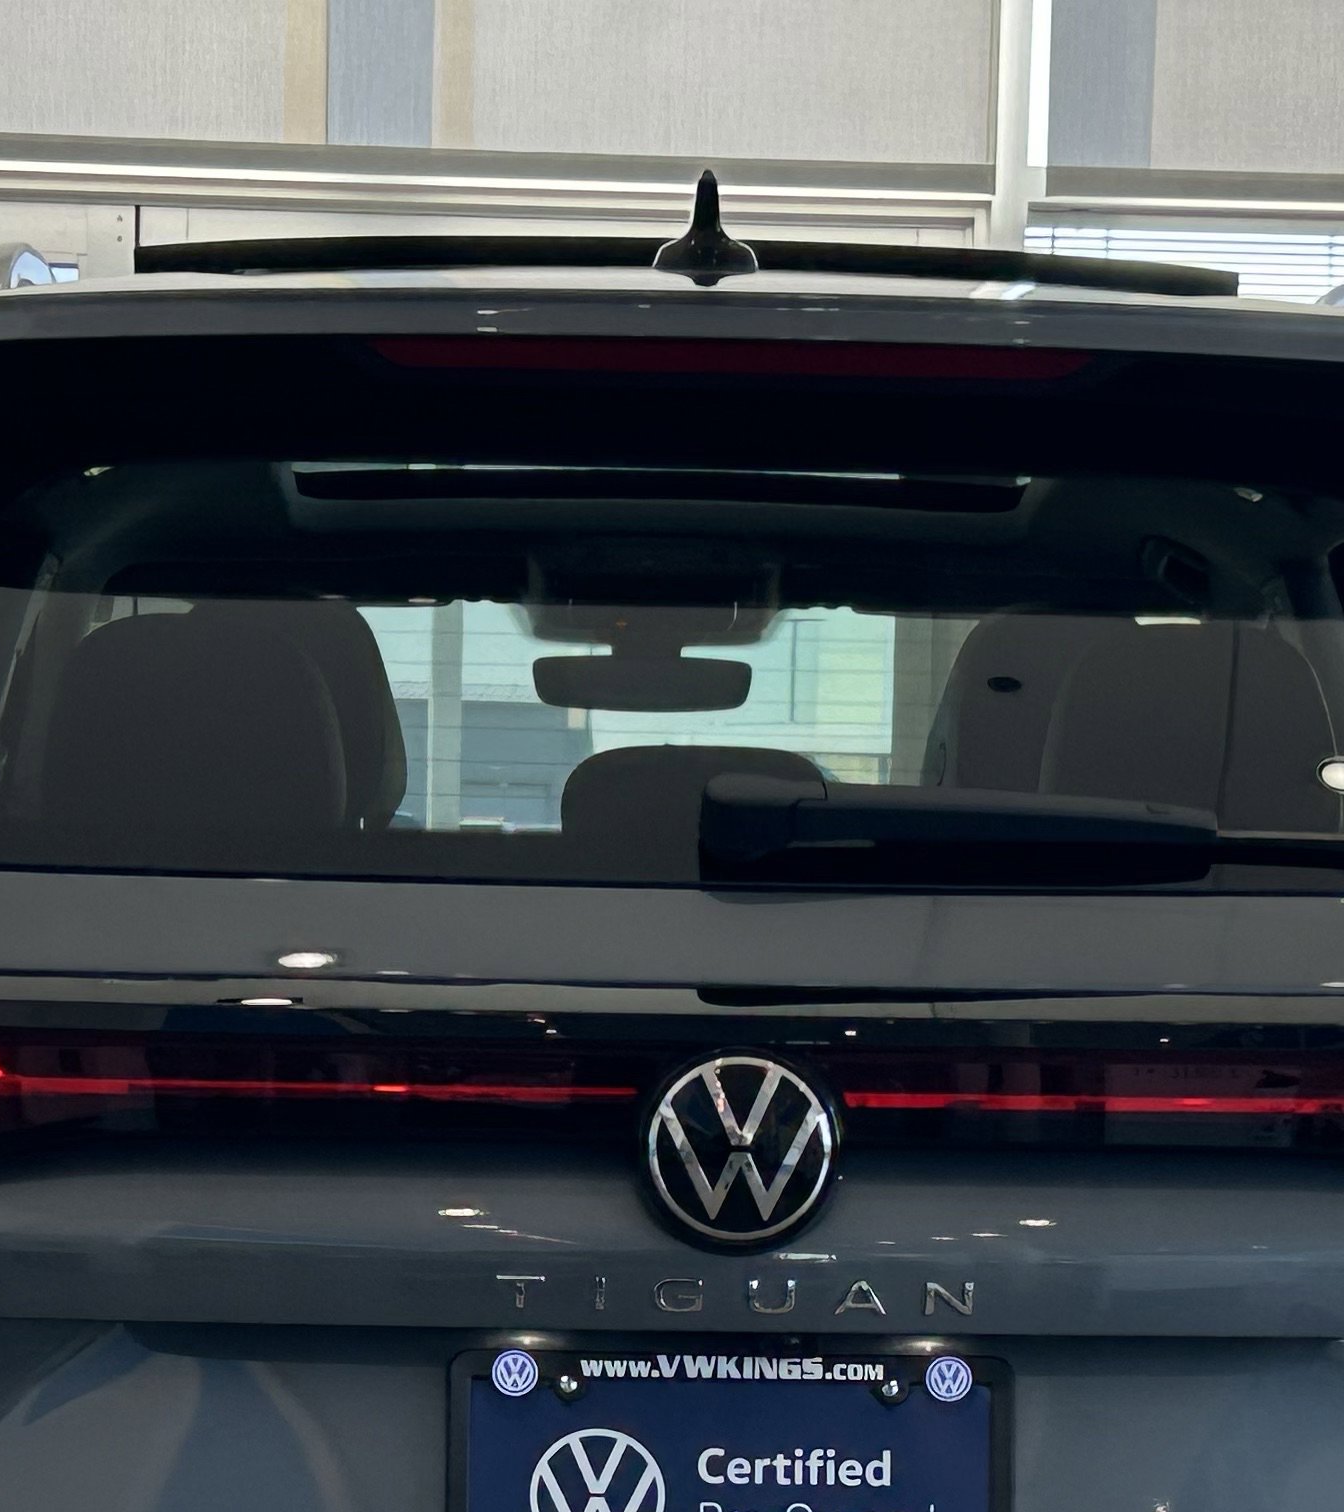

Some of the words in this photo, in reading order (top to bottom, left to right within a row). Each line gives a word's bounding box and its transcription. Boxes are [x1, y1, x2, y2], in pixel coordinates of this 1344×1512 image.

[653, 1060, 835, 1228] VW
[495, 1274, 975, 1317] TIGUAN
[697, 1447, 892, 1487] Certified
